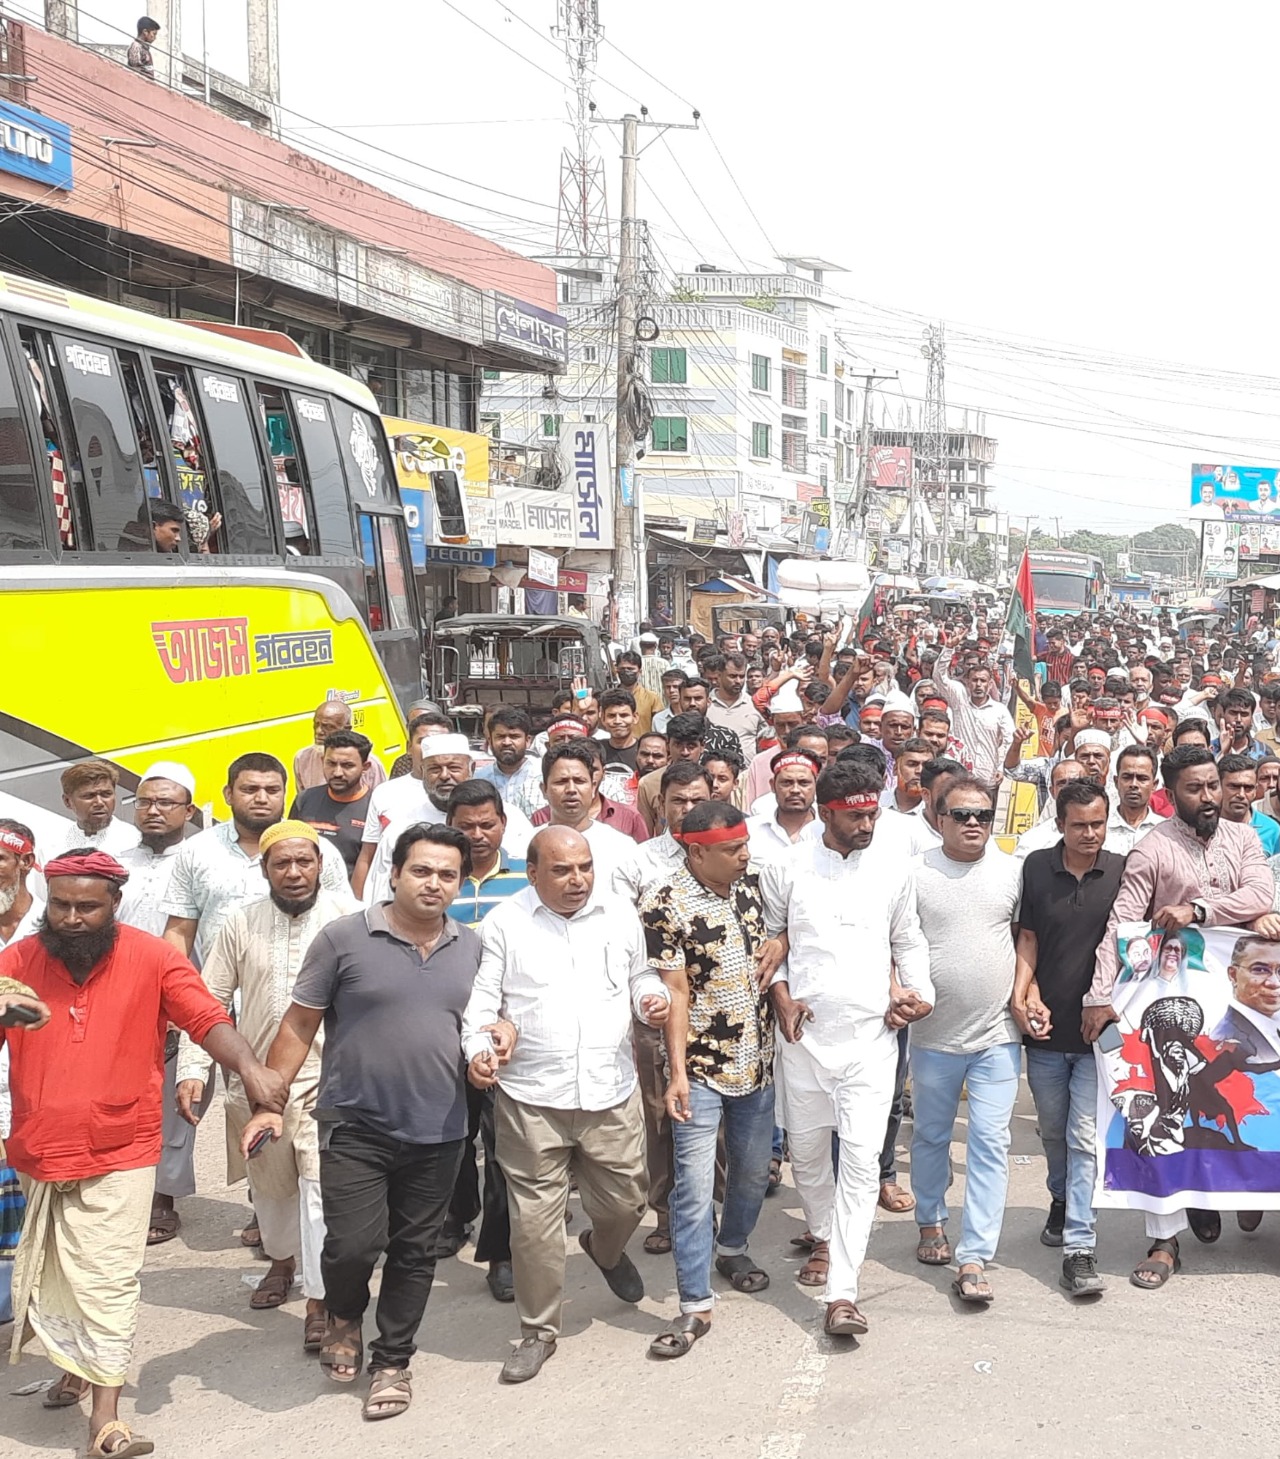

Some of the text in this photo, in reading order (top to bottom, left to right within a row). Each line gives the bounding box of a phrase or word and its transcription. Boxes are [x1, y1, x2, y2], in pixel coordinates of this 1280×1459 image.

[497, 305, 566, 350] খেলাঘর
[65, 344, 112, 377] পরিবহন
[574, 431, 604, 541] মার্সেল
[528, 503, 572, 530] মার্সেল
[428, 549, 482, 562] TECNO
[254, 630, 334, 673] পরিবহন
